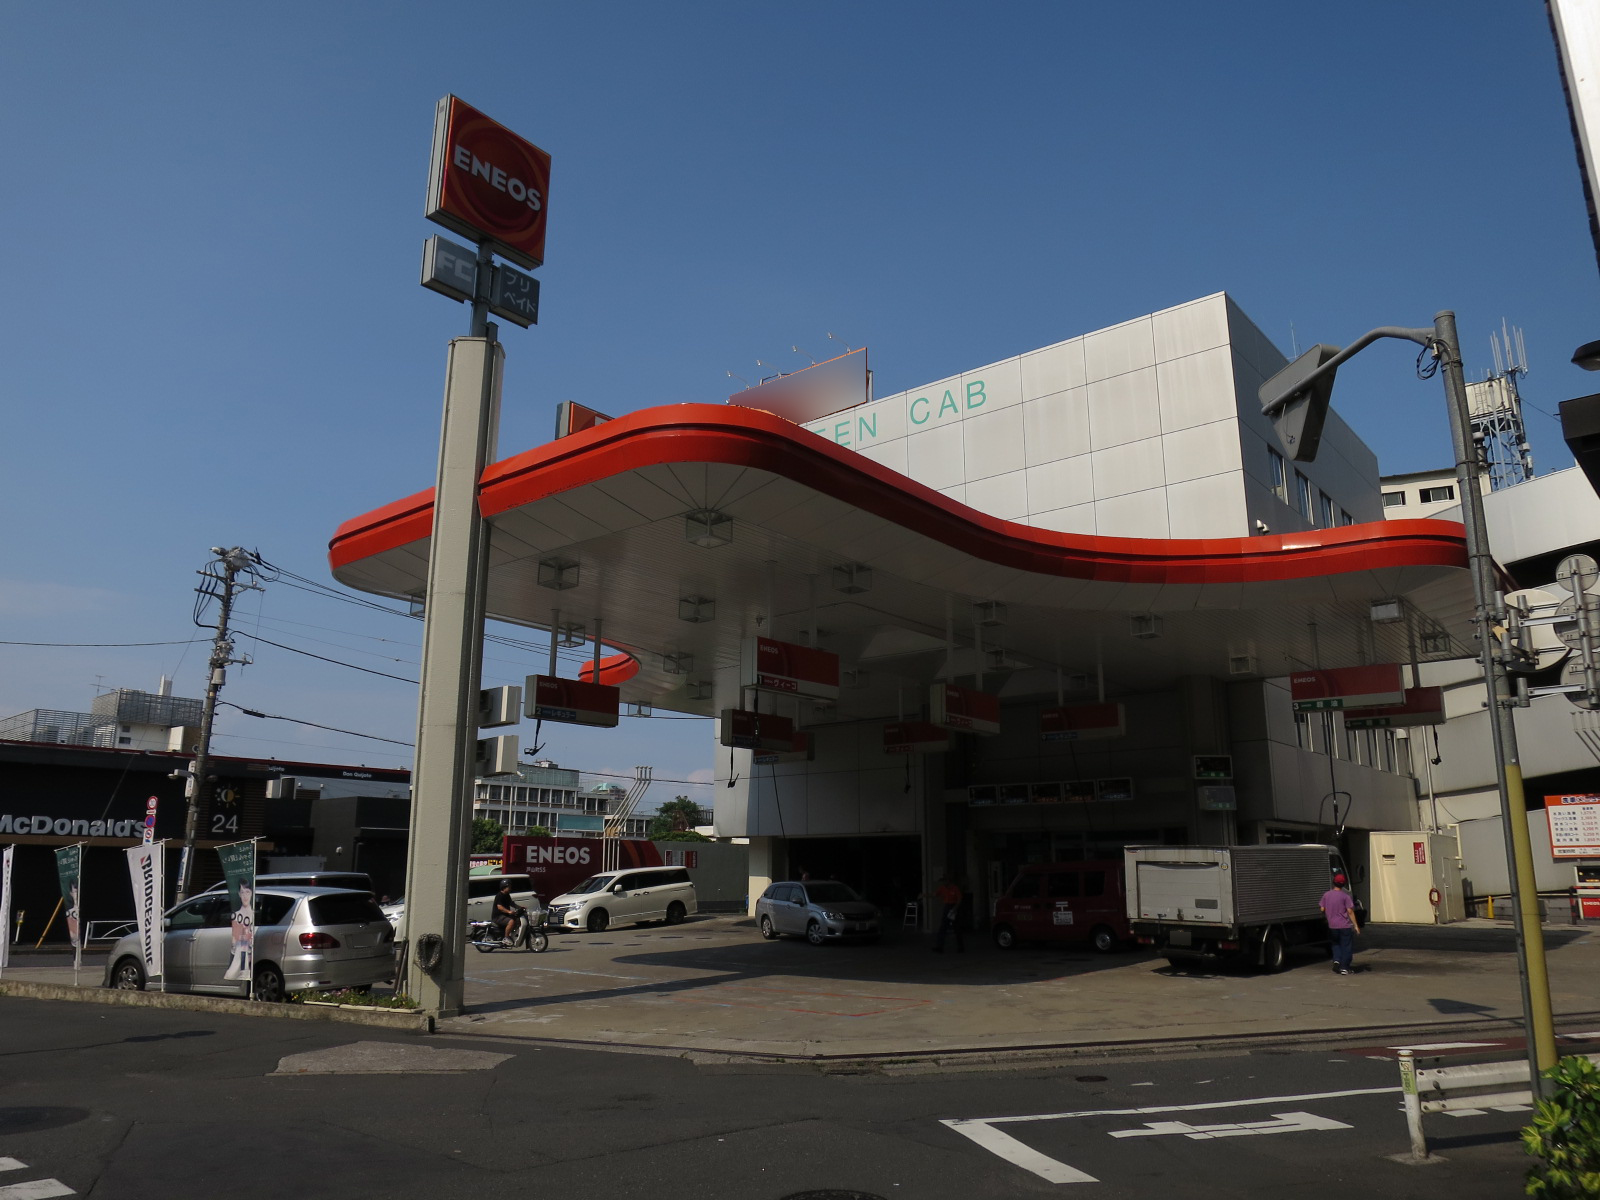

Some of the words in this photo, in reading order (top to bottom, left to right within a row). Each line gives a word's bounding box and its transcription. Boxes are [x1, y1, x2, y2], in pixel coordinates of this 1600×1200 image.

[453, 144, 541, 212] ENEOS
[436, 250, 474, 282] FC
[909, 379, 988, 425] CAB
[759, 643, 779, 655] ENEOS
[539, 681, 558, 690] ENEOS
[535, 707, 543, 716] 2
[211, 813, 239, 834] 24
[526, 845, 591, 865] ENEOS
